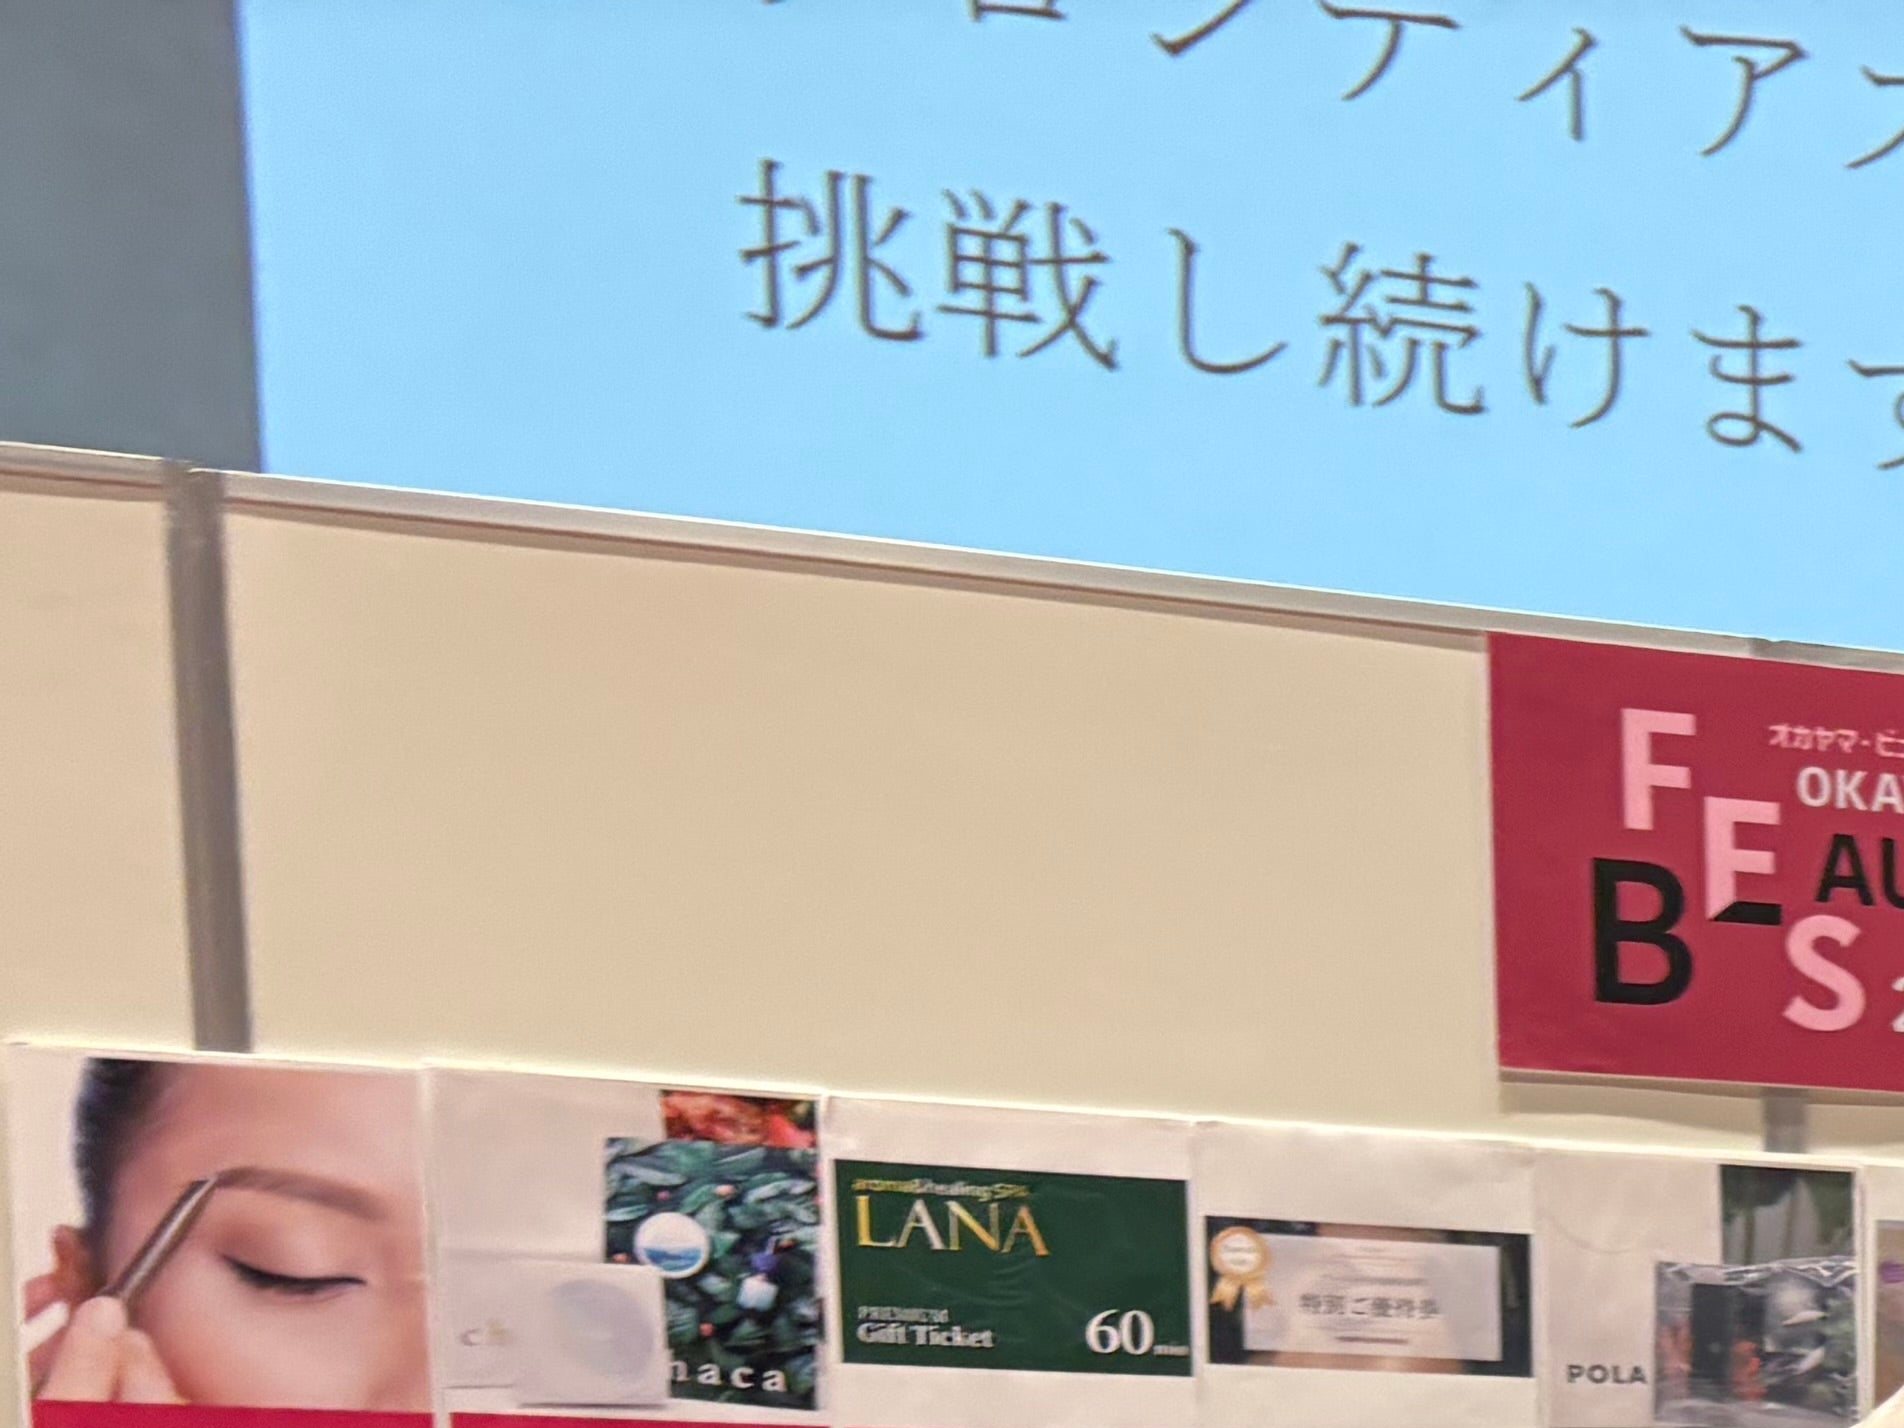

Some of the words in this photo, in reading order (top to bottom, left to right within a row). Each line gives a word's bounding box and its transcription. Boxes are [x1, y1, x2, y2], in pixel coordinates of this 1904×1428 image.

[855, 1195, 1050, 1257] LANA
[1085, 1308, 1154, 1356] 60
[1567, 1363, 1648, 1386] POLA
